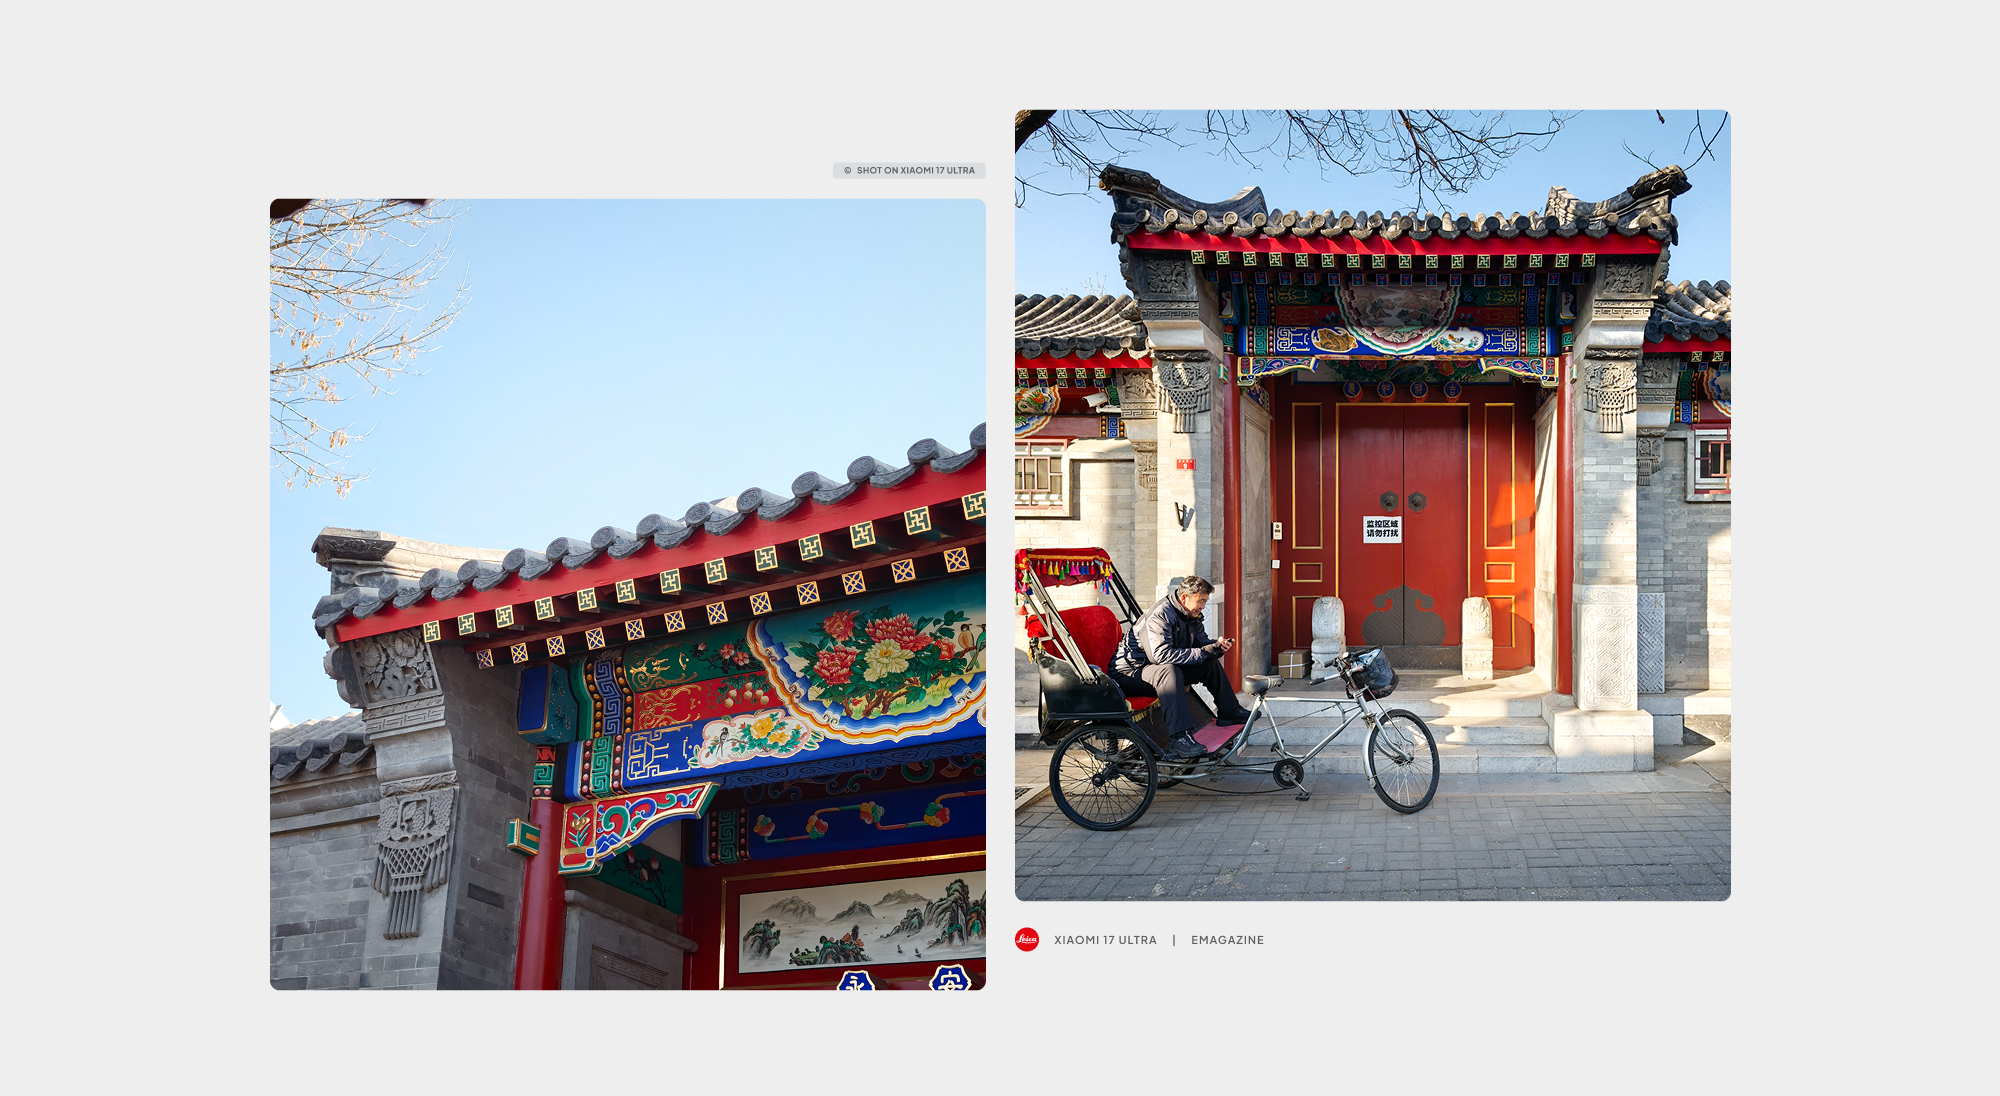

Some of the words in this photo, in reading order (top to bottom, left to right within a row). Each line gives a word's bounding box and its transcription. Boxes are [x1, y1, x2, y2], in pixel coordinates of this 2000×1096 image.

[1366, 519, 1399, 528] 监控区域
[1366, 529, 1399, 537] 请勿打扰
